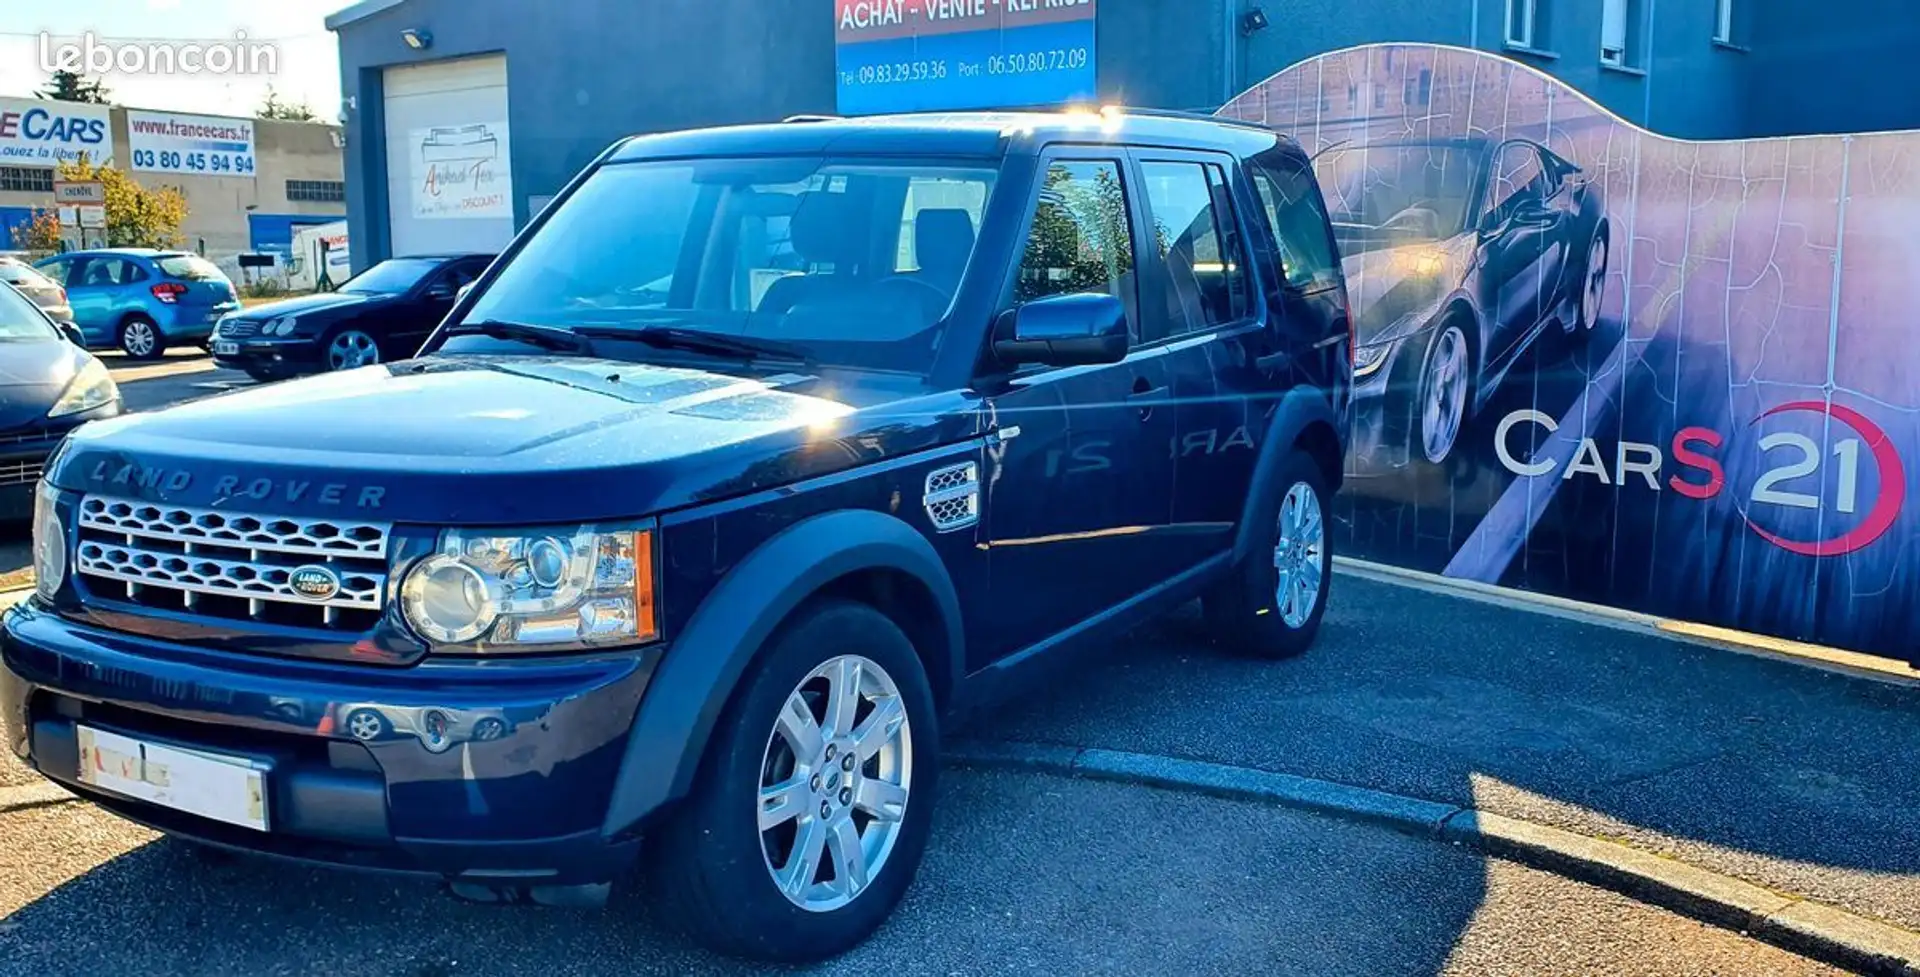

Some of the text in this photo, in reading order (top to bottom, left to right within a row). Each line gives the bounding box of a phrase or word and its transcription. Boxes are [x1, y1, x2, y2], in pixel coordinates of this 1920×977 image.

[840, 0, 905, 30] ACHAT
[988, 47, 1086, 75] 06.50.80.72.09
[132, 119, 251, 141] www.francecars.fr
[0, 146, 34, 157] ouez
[38, 144, 50, 158] la
[133, 149, 254, 173] 03 80 45 94 94
[90, 460, 387, 508] LAND ROVER
[1750, 431, 1860, 514] 21
